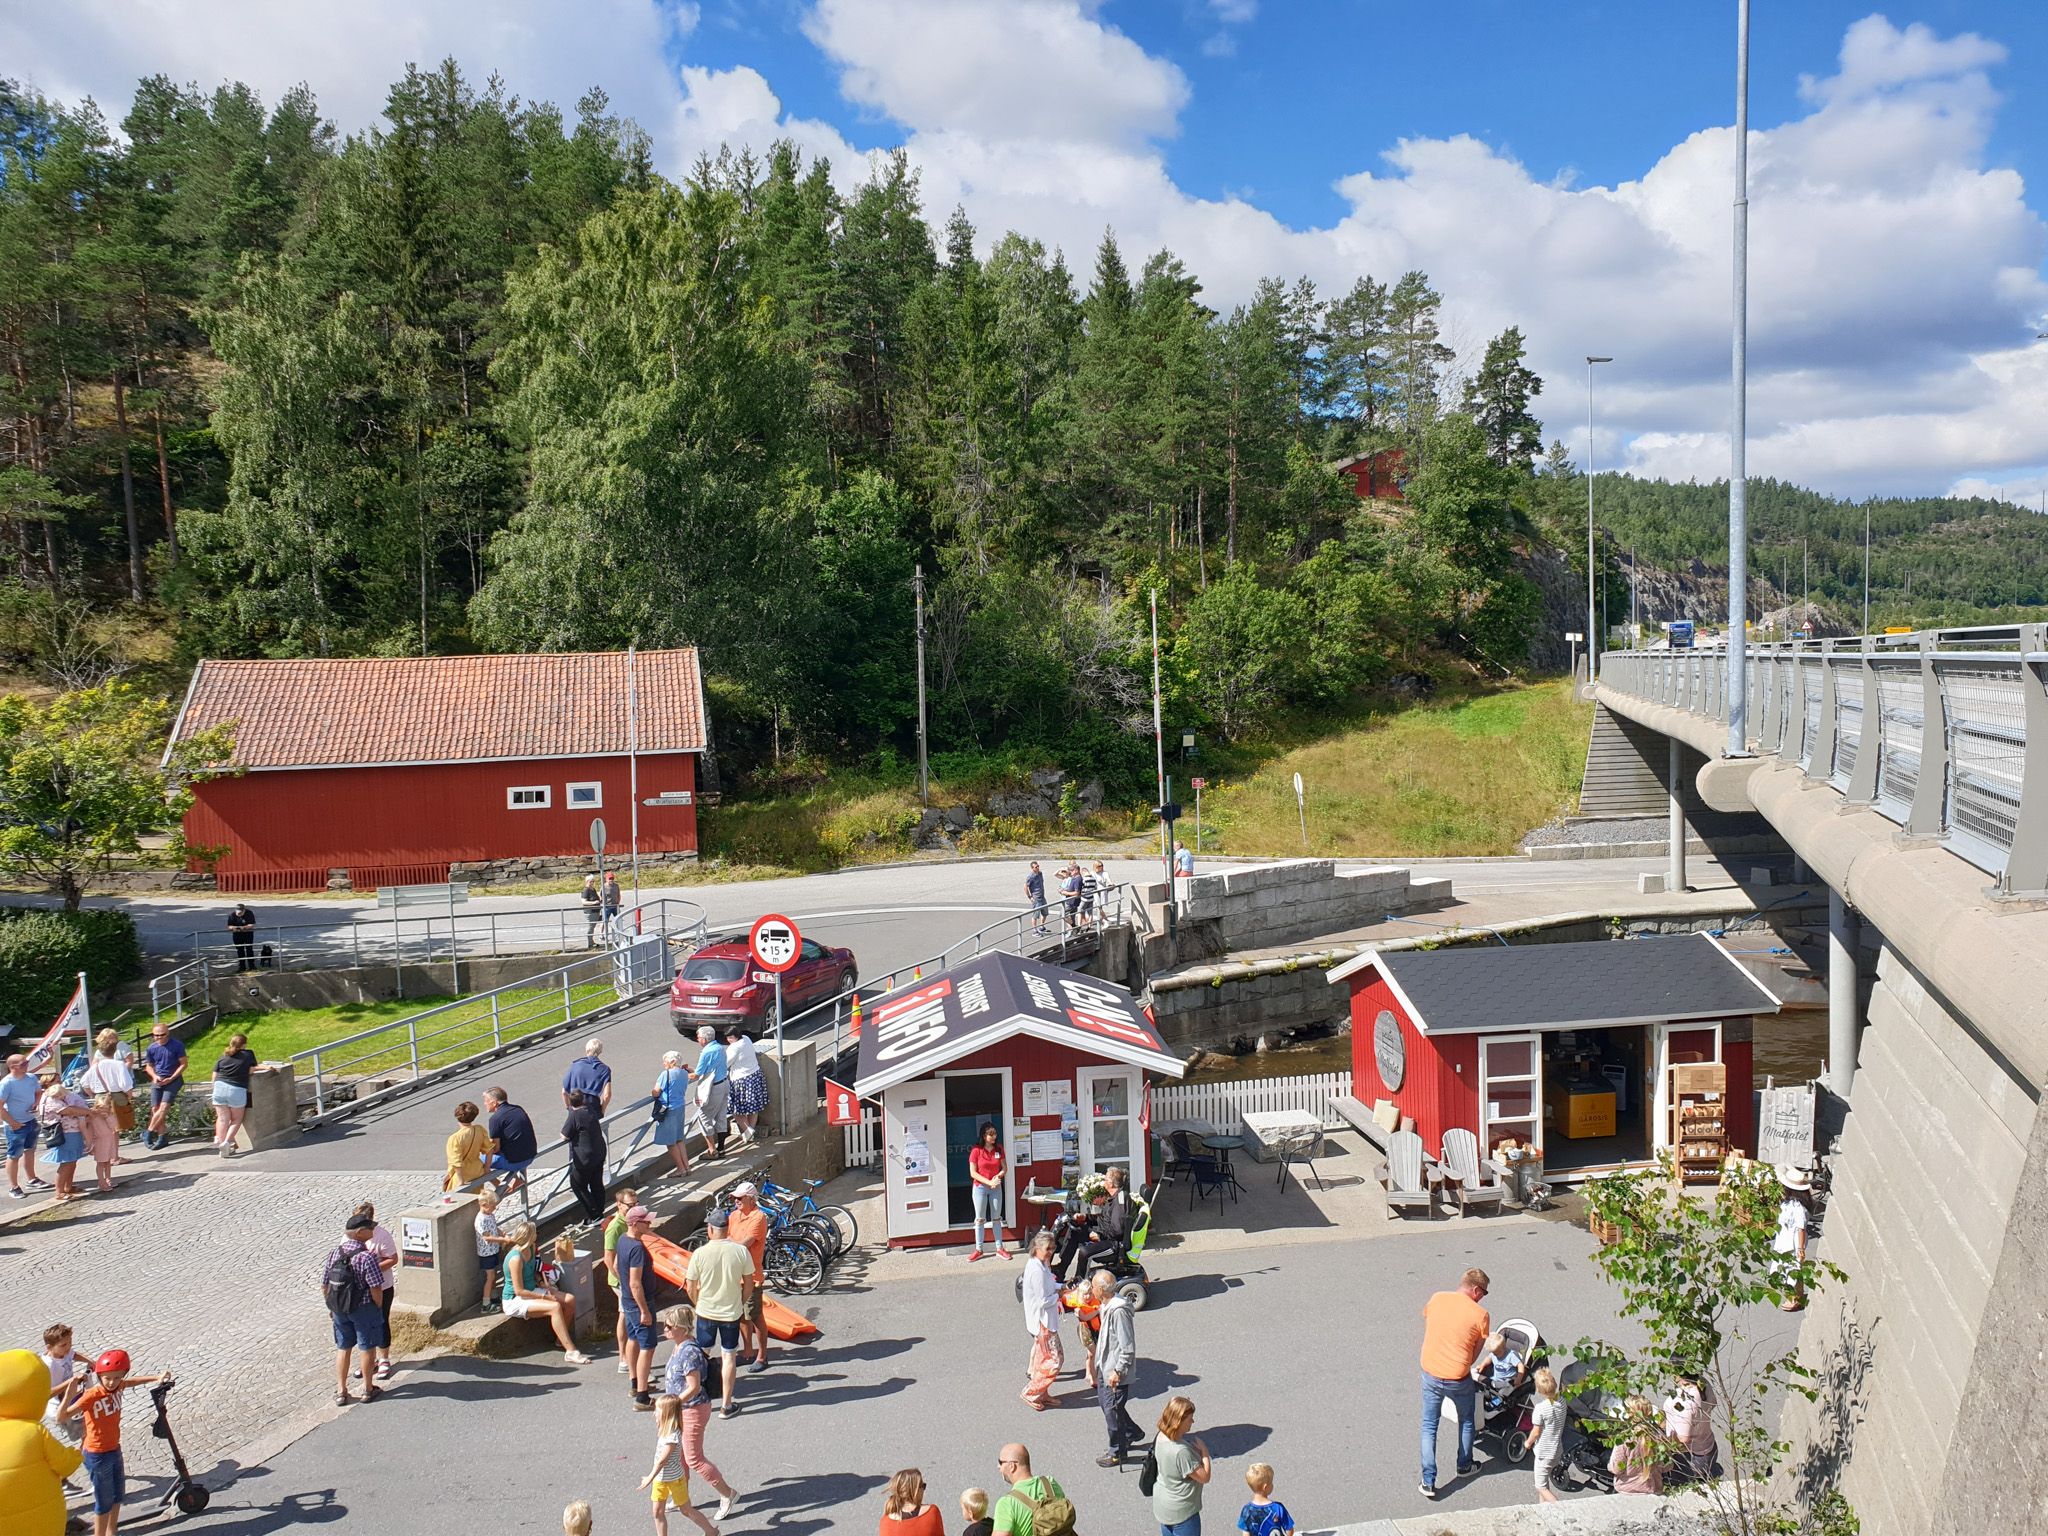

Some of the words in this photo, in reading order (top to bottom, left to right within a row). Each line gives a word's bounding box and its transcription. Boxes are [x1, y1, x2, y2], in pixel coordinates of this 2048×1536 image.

[770, 946, 780, 955] 15
[957, 972, 991, 1019] TOURIST
[1021, 970, 1062, 1013] TOURIST
[1763, 1126, 1809, 1144] Matfatet
